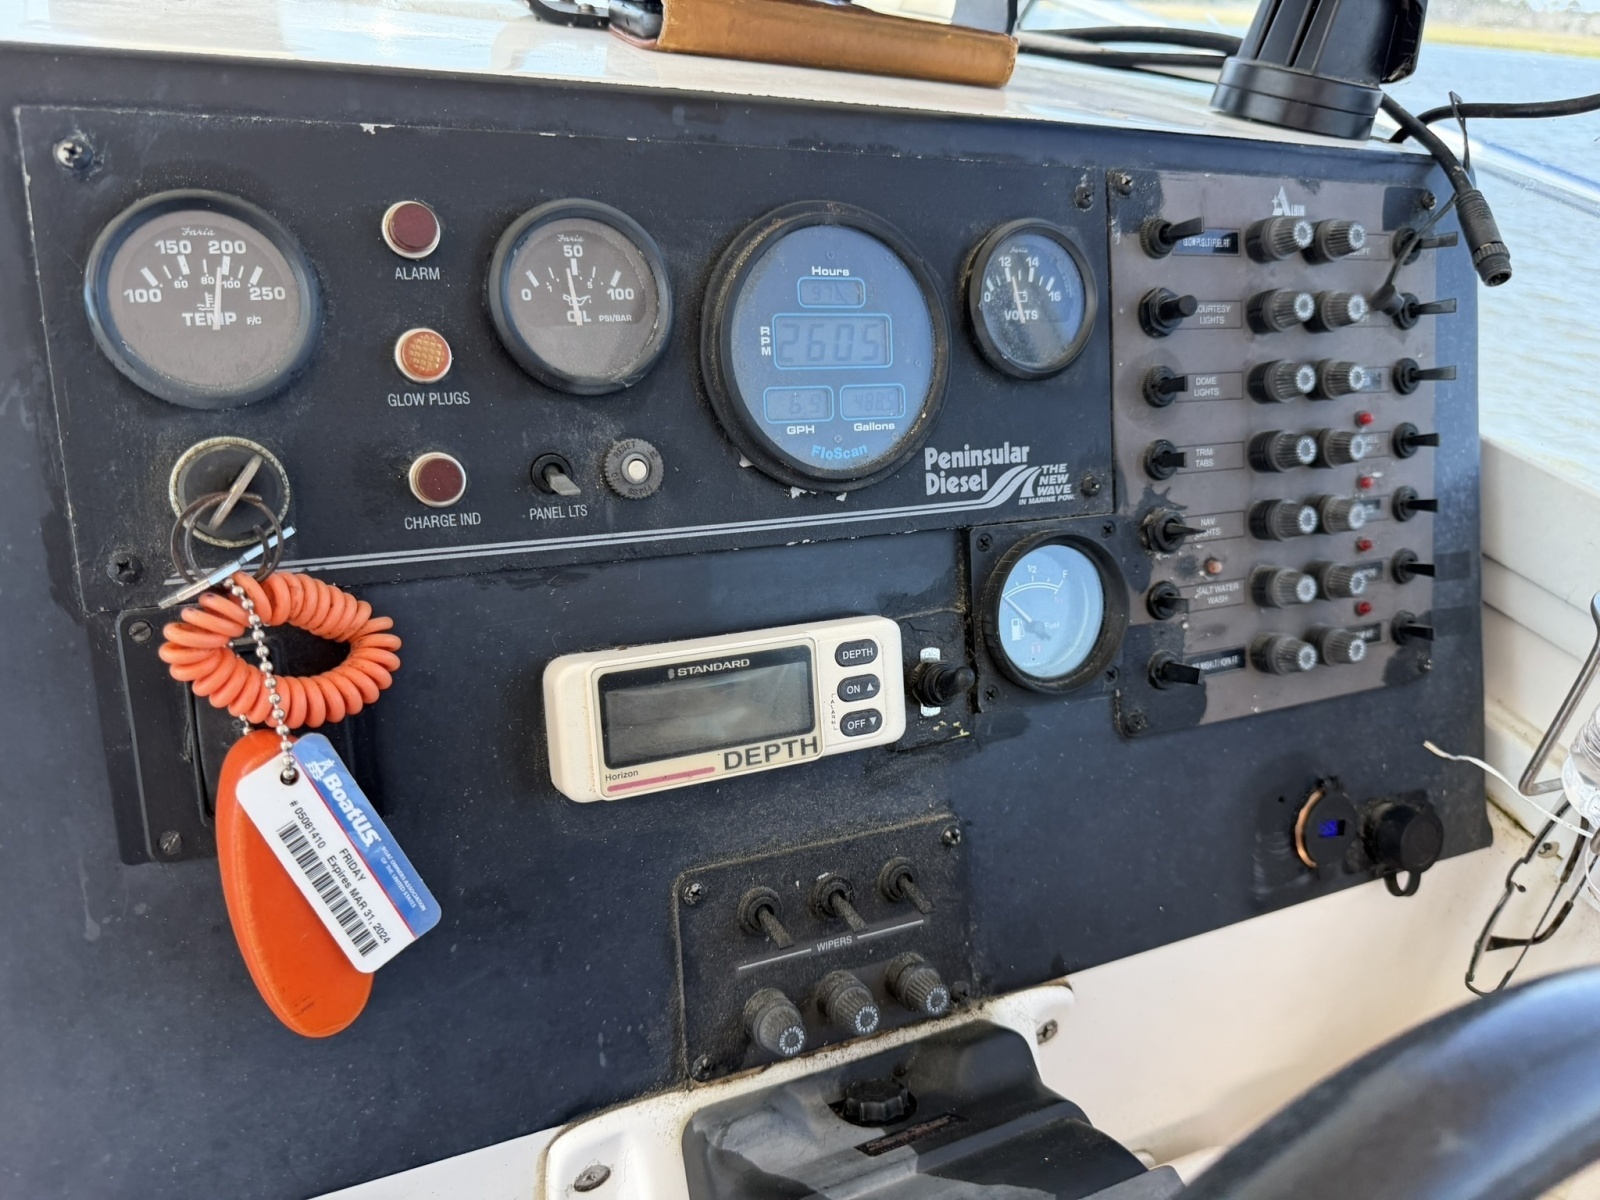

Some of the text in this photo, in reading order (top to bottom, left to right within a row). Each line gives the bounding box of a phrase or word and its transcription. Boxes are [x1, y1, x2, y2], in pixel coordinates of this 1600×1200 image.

[154, 240, 192, 255] 150
[208, 240, 247, 255] 200
[563, 244, 583, 257] 50
[998, 256, 1012, 267] 12
[1025, 256, 1040, 267] 14
[395, 266, 441, 281] ALARM
[811, 266, 850, 276] Hours
[174, 280, 189, 289] 60
[200, 276, 215, 285] 80
[221, 280, 241, 289] 100
[123, 288, 162, 303] 100
[249, 286, 286, 301] 250
[521, 288, 532, 301] 0
[606, 287, 635, 301] 100
[984, 291, 991, 303] 0
[1048, 291, 1061, 302] 16
[246, 315, 262, 326] F/C
[567, 310, 632, 323] OL PSI/BAR
[1004, 310, 1038, 320] VOTS
[1199, 316, 1225, 325] LIGHTS
[781, 323, 880, 362] 2605
[1195, 376, 1217, 386] DOME
[387, 391, 471, 407] GLOW PLUGS
[1193, 388, 1219, 397] LIGHTS
[786, 424, 815, 435] GPH
[853, 422, 896, 432] Gallons
[810, 444, 868, 460] FloScan
[924, 441, 1030, 471] Peninsular
[1195, 448, 1214, 457] TRIM
[1041, 463, 1068, 474] THE
[1195, 459, 1214, 468] TABS
[925, 467, 988, 496] Diesel
[1038, 473, 1070, 486] NEW
[1036, 484, 1072, 497] WAVE
[1028, 496, 1056, 505] MARINE
[529, 504, 588, 521] PANEL LTS
[404, 512, 482, 530] CHARGE IND
[1200, 517, 1215, 527] NAV
[1063, 570, 1069, 579] F
[1214, 581, 1239, 594] WATER
[1207, 595, 1228, 605] WASH
[842, 647, 874, 660] DEPTH
[677, 658, 750, 676] STANDARD
[846, 685, 861, 695] ON
[847, 718, 866, 730] OFF
[723, 736, 819, 771] DEPTH
[605, 769, 639, 782] Horizon
[294, 807, 327, 849] 05081410
[339, 848, 367, 882] FRIDAY
[326, 855, 391, 944] Expires MAR 31, 2024
[816, 935, 853, 953] WIPERS
